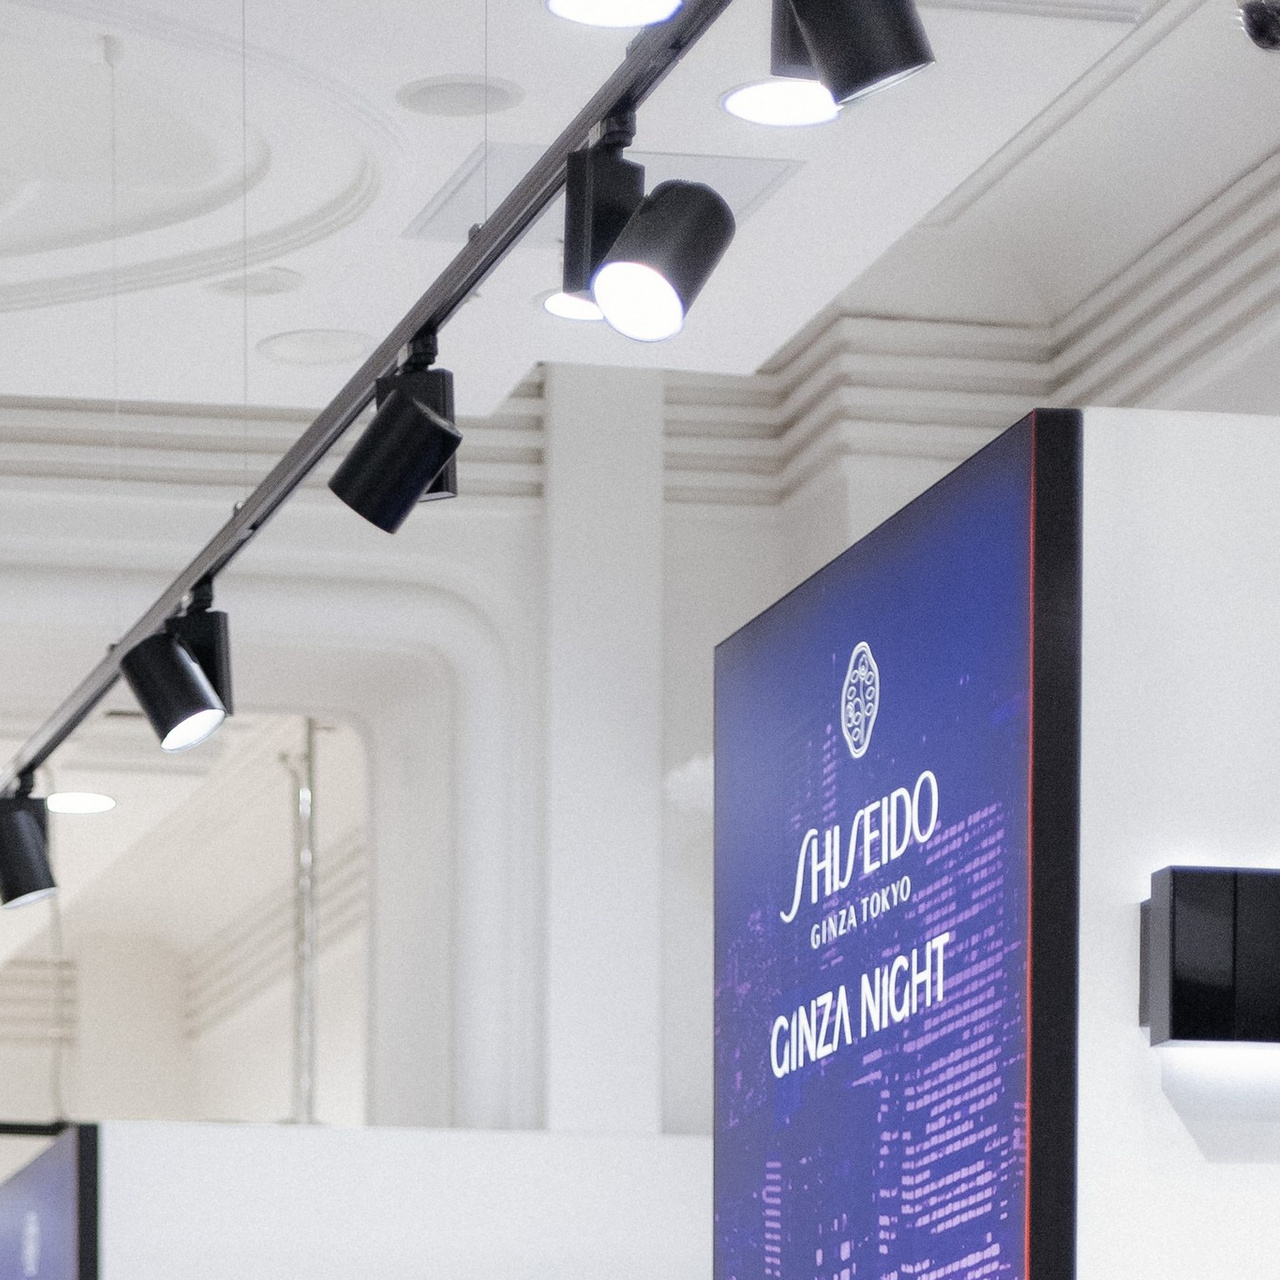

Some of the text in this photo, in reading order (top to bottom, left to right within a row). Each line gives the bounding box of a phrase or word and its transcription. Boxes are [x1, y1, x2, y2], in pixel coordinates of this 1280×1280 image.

[780, 770, 938, 923] SHISEIDO
[810, 875, 911, 949] GINZA TOKYO
[770, 932, 950, 1078] GINZA NIGHT
